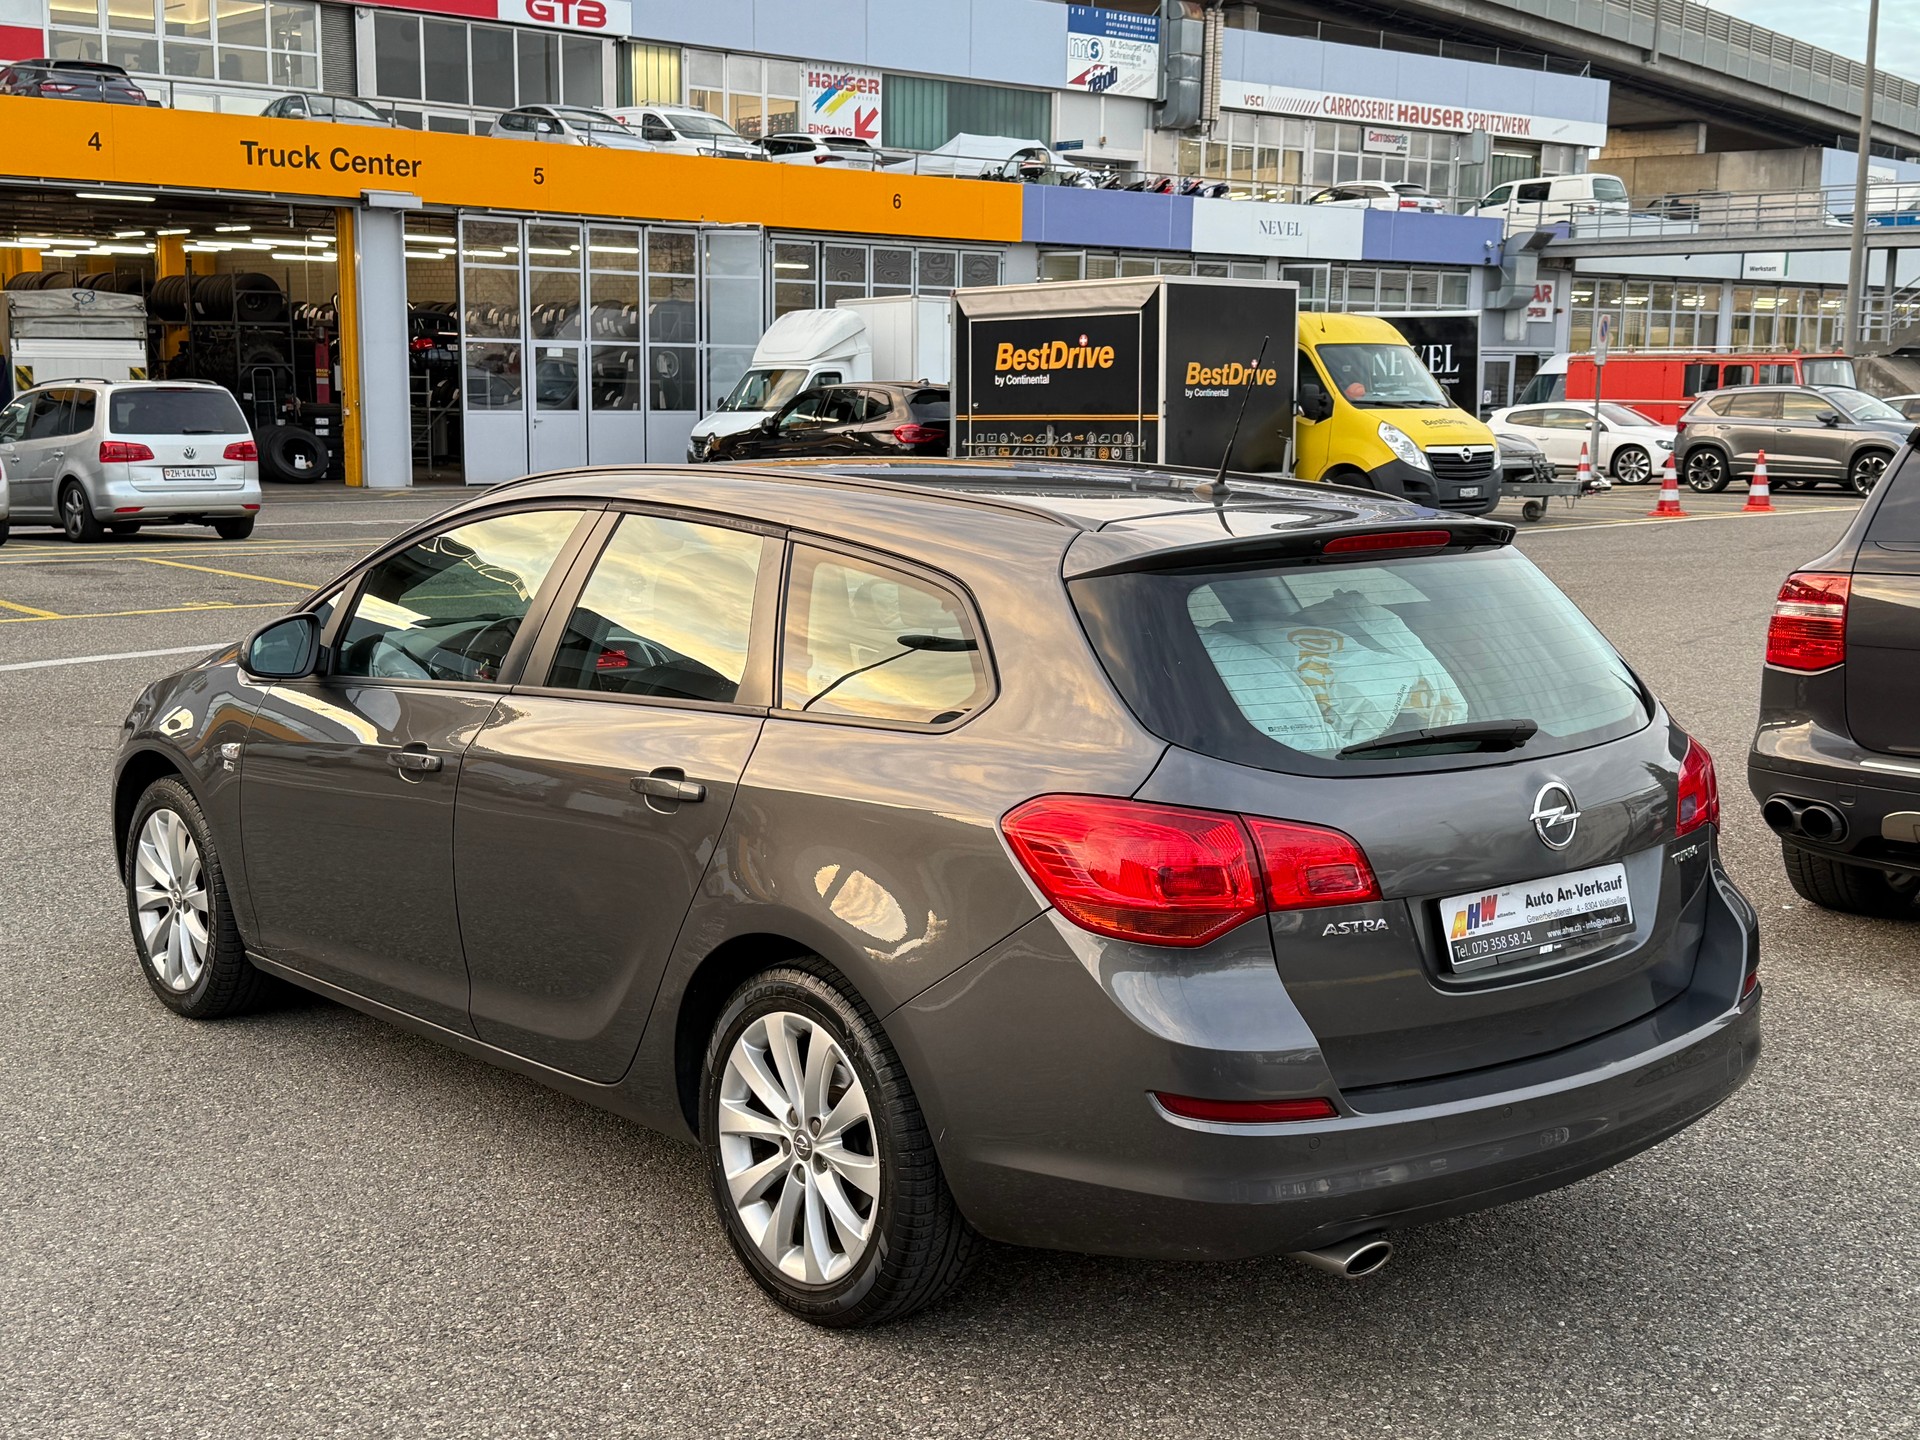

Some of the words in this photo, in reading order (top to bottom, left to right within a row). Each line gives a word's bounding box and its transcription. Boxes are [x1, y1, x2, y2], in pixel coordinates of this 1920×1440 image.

[526, 0, 606, 28] GTB
[1244, 94, 1264, 107] VSCI
[1323, 96, 1394, 121] CARROSSERIE
[1466, 112, 1531, 136] SPRITZWERK
[808, 123, 853, 136] EINGANG
[88, 132, 102, 151] 4
[240, 140, 321, 170] Truck
[330, 146, 422, 178] Center
[534, 168, 544, 184] 5
[893, 194, 902, 209] 6
[1259, 220, 1302, 236] NEVEL
[995, 334, 1114, 370] BestDrive
[994, 375, 1005, 387] by
[1006, 374, 1050, 385] Continental
[1185, 388, 1193, 398] by
[1194, 388, 1229, 397] Continental
[1525, 890, 1553, 908] Auto
[1557, 876, 1622, 902] An-Verkauf
[1584, 901, 1598, 911] 8304
[1598, 896, 1626, 908] Wallisellen
[1450, 894, 1498, 939] AHW
[1322, 918, 1389, 936] ASTRA
[1546, 923, 1582, 938] www.ahw.ch
[1585, 915, 1621, 930] info@ahw.ch
[1455, 944, 1471, 959] Tel.
[1472, 938, 1489, 955] 079
[1491, 935, 1507, 951] 358
[1508, 933, 1520, 947] 58
[1520, 930, 1532, 945] 24
